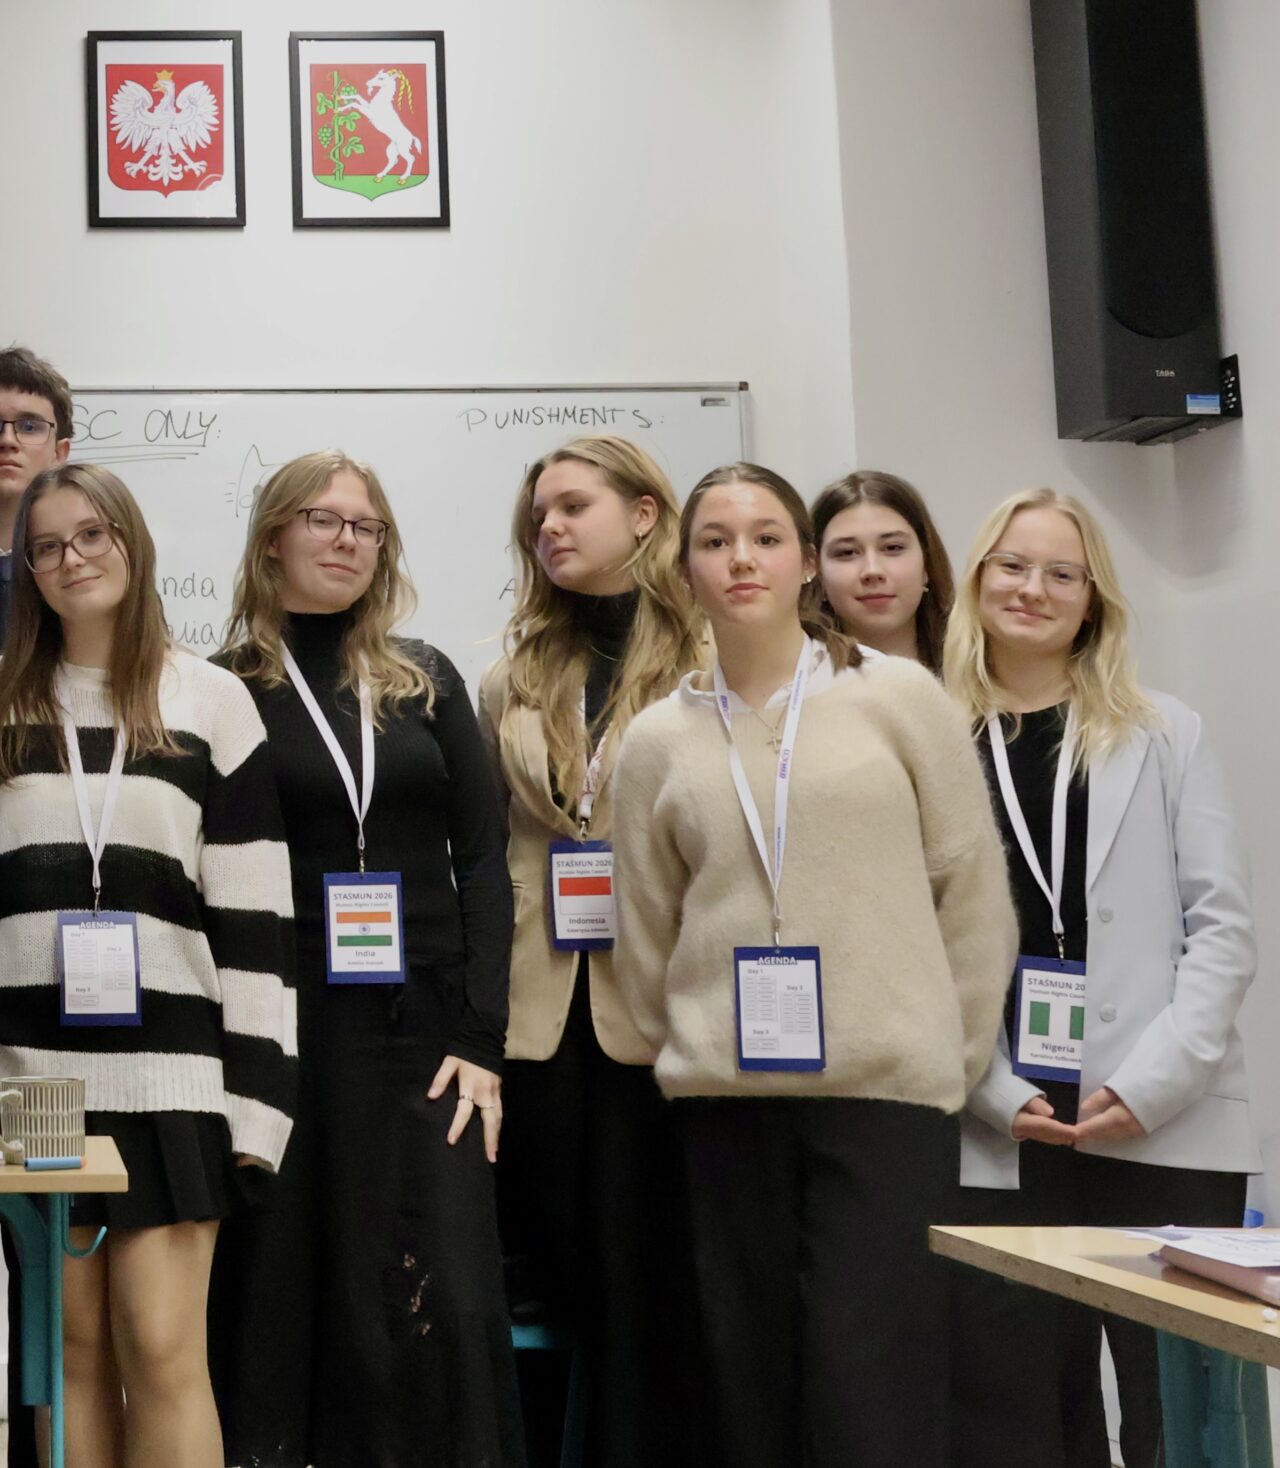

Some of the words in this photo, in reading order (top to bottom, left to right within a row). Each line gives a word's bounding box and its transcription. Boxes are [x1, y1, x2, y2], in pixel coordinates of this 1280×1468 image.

[162, 571, 218, 601] nda
[375, 892, 393, 900] 2026
[79, 921, 116, 929] AGENDA
[569, 917, 606, 925] Indonesia
[757, 956, 798, 965] AGENDA
[1027, 977, 1072, 990] STAŚMUN
[1074, 983, 1085, 991] 20
[1041, 1042, 1075, 1053] Nigeria
